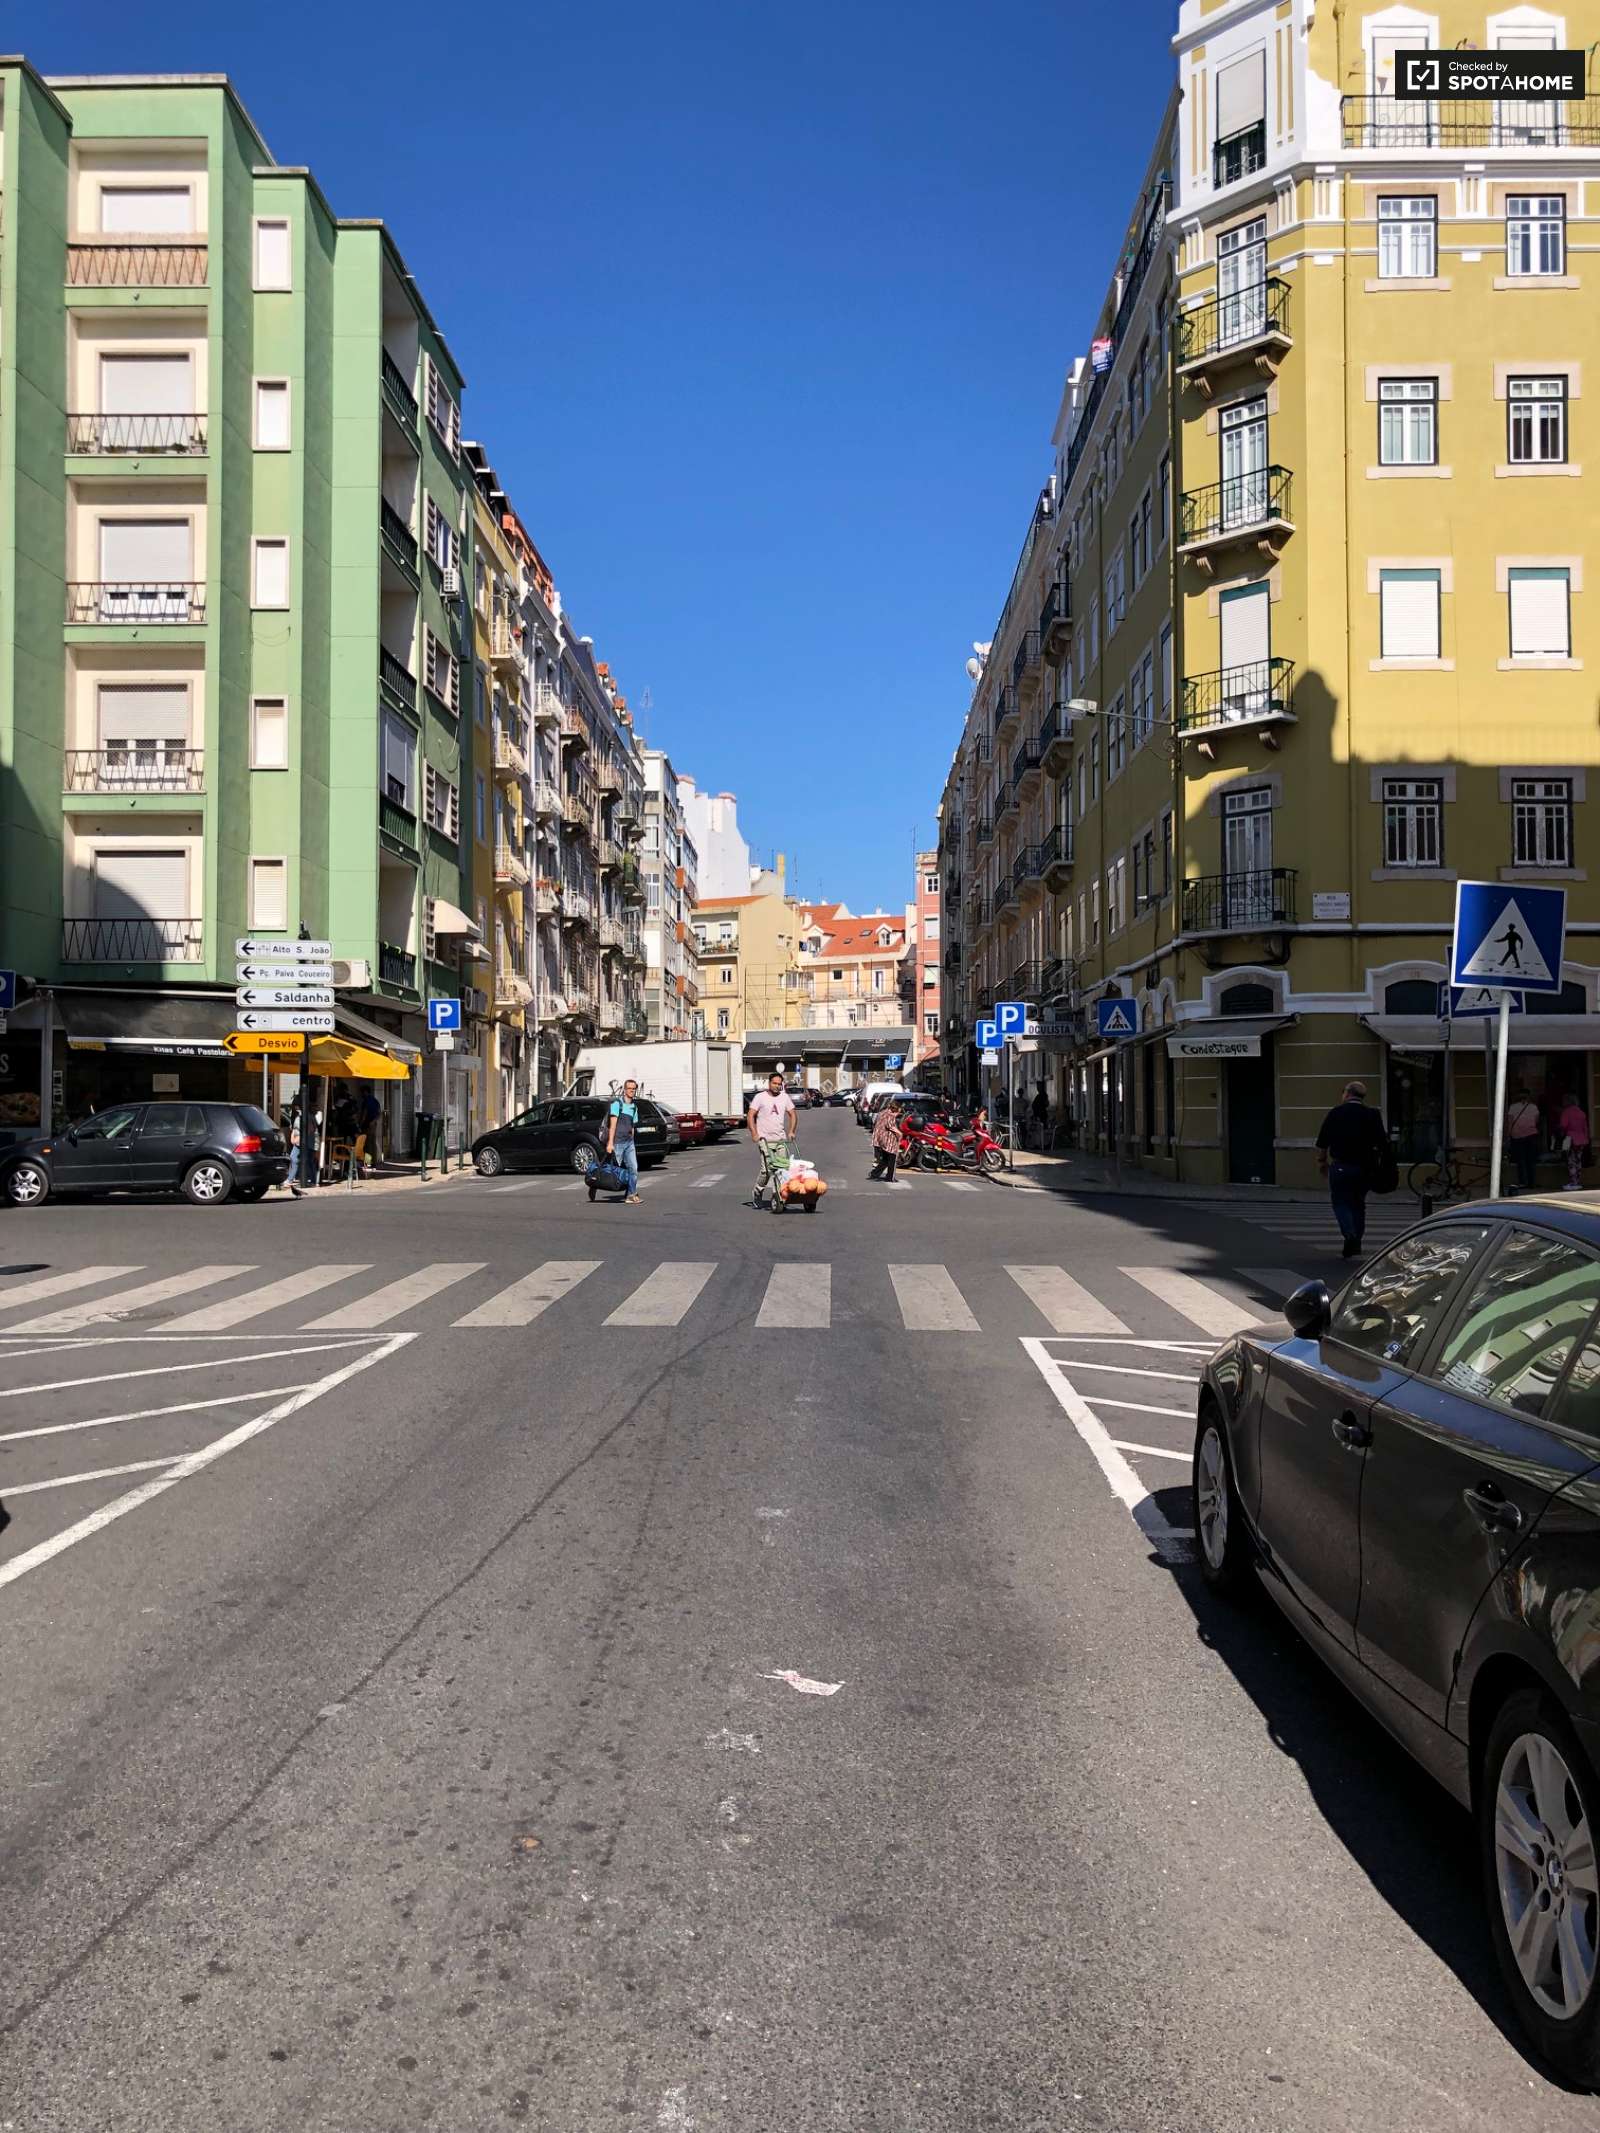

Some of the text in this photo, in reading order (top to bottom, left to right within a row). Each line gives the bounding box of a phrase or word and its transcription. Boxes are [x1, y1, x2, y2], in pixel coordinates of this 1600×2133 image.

[310, 946, 330, 954] João
[275, 969, 295, 978] Paiva
[274, 992, 330, 1003] Saldanha
[436, 1003, 453, 1026] P
[1001, 1005, 1019, 1031] P
[292, 1016, 331, 1025] centro
[982, 1023, 996, 1045] P
[1028, 1024, 1071, 1034] OCULISTA
[258, 1038, 298, 1048] Desvio
[176, 1046, 195, 1055] Café
[771, 1104, 779, 1115] A
